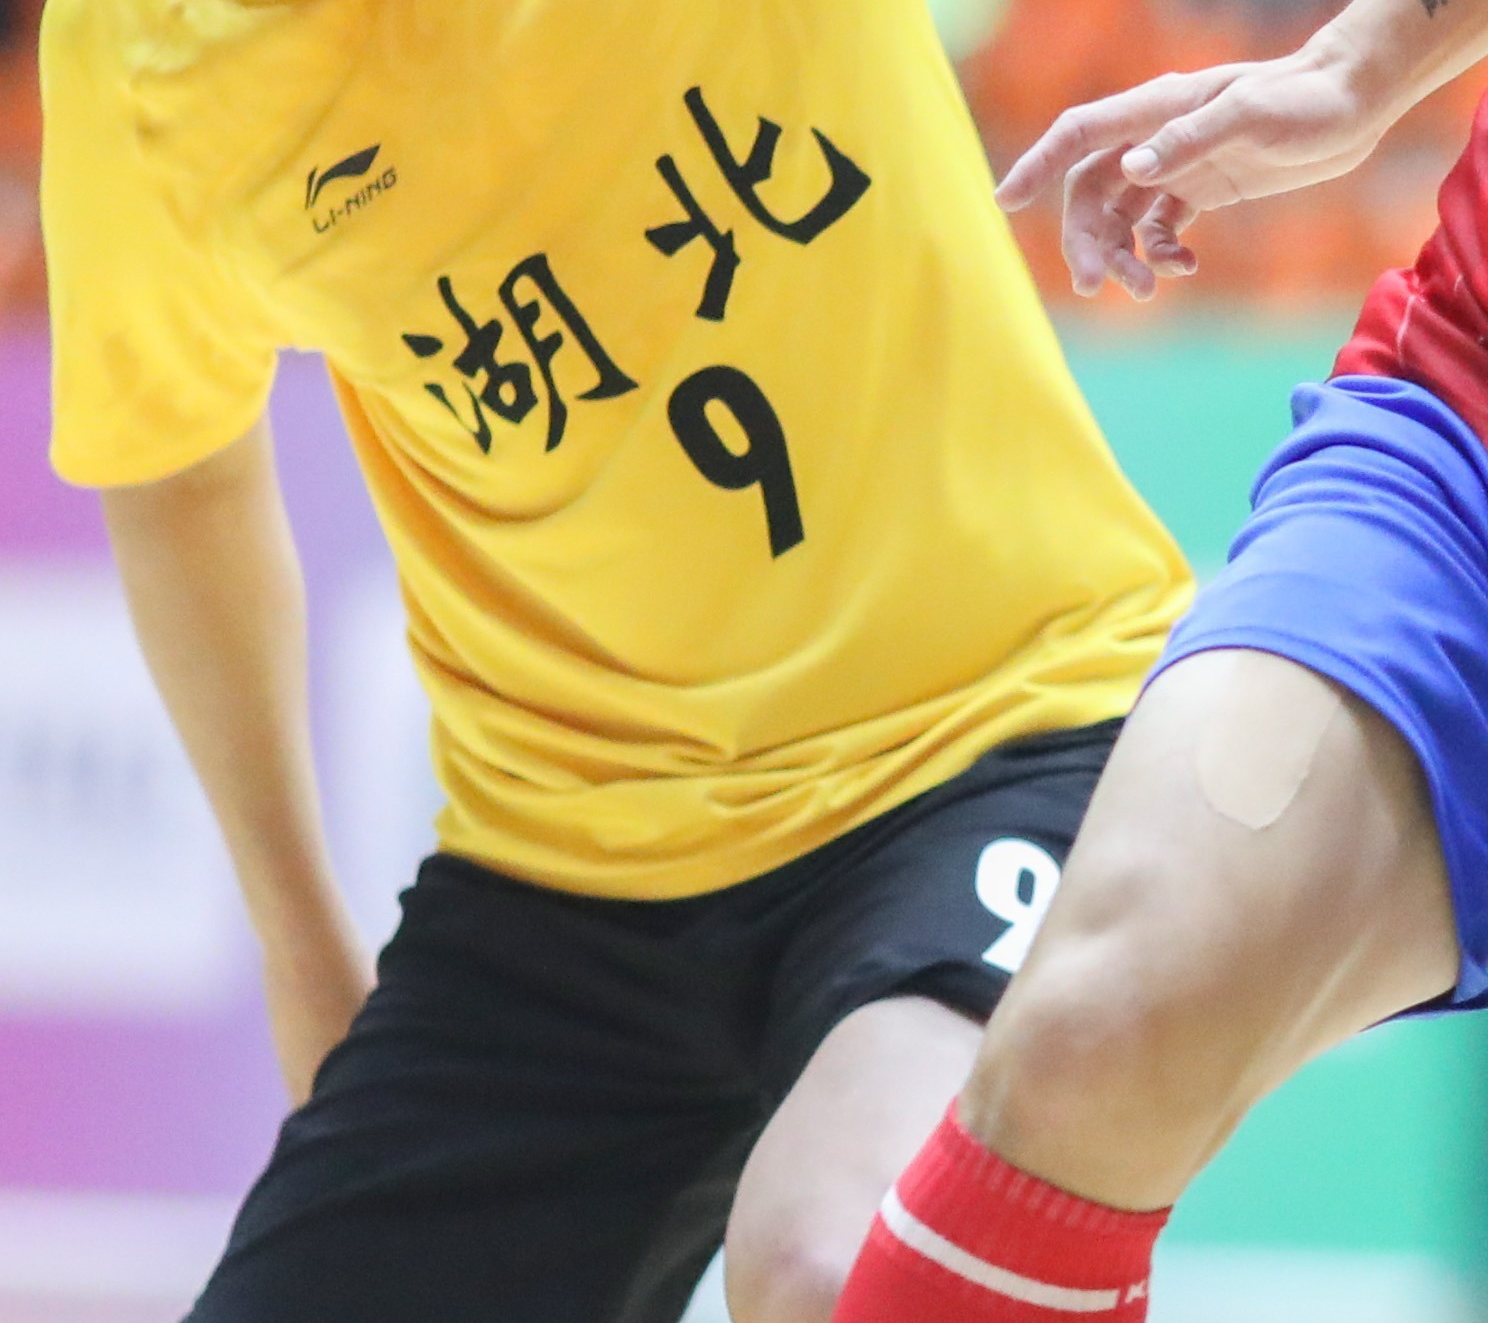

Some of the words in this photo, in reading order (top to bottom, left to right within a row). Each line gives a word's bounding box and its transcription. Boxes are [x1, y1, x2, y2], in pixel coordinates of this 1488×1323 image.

[311, 165, 398, 235] LI-NING
[401, 85, 873, 455] 湖北
[665, 364, 806, 560] 9
